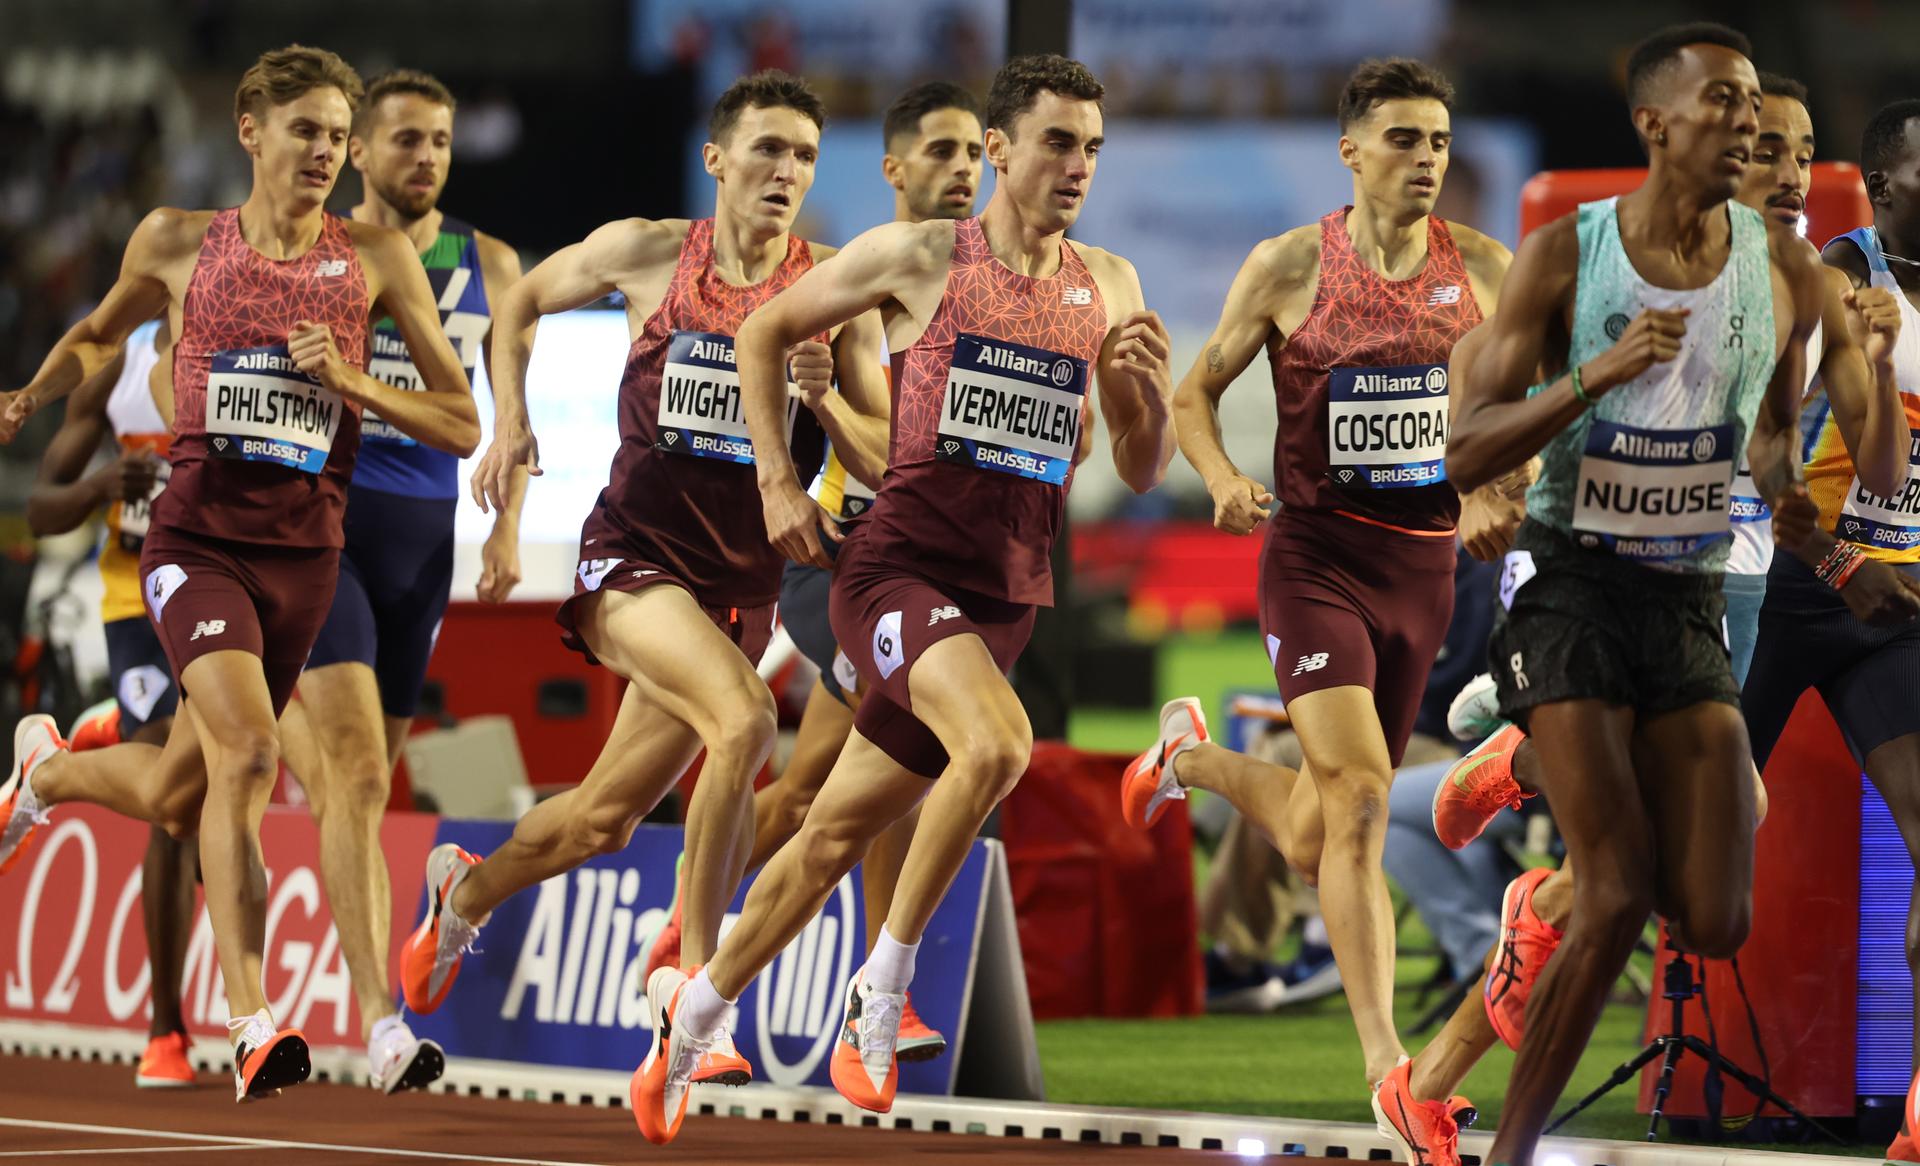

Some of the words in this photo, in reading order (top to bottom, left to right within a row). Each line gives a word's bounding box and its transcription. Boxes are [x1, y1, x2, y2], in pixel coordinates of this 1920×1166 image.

[690, 340, 736, 364] Allia
[976, 345, 1049, 378] Allianz
[1352, 374, 1423, 393] Allianz
[217, 385, 333, 437] PIHLSTRÖM
[667, 376, 746, 424] WIGHT
[950, 382, 1078, 446] VERMEULEN
[1334, 409, 1449, 452] COSCORA
[243, 440, 308, 463] BRUSSELS
[693, 435, 755, 458] BRUSSEL
[1610, 431, 1690, 459] Allianz
[976, 447, 1047, 474] BRUSSELS
[1371, 465, 1438, 482] BRUSSELS
[1584, 479, 1725, 515] NUGUSE
[1616, 539, 1697, 557] BRUSSELS
[190, 619, 226, 641] NB
[1291, 653, 1329, 676] NB
[501, 867, 739, 1034] Allia
